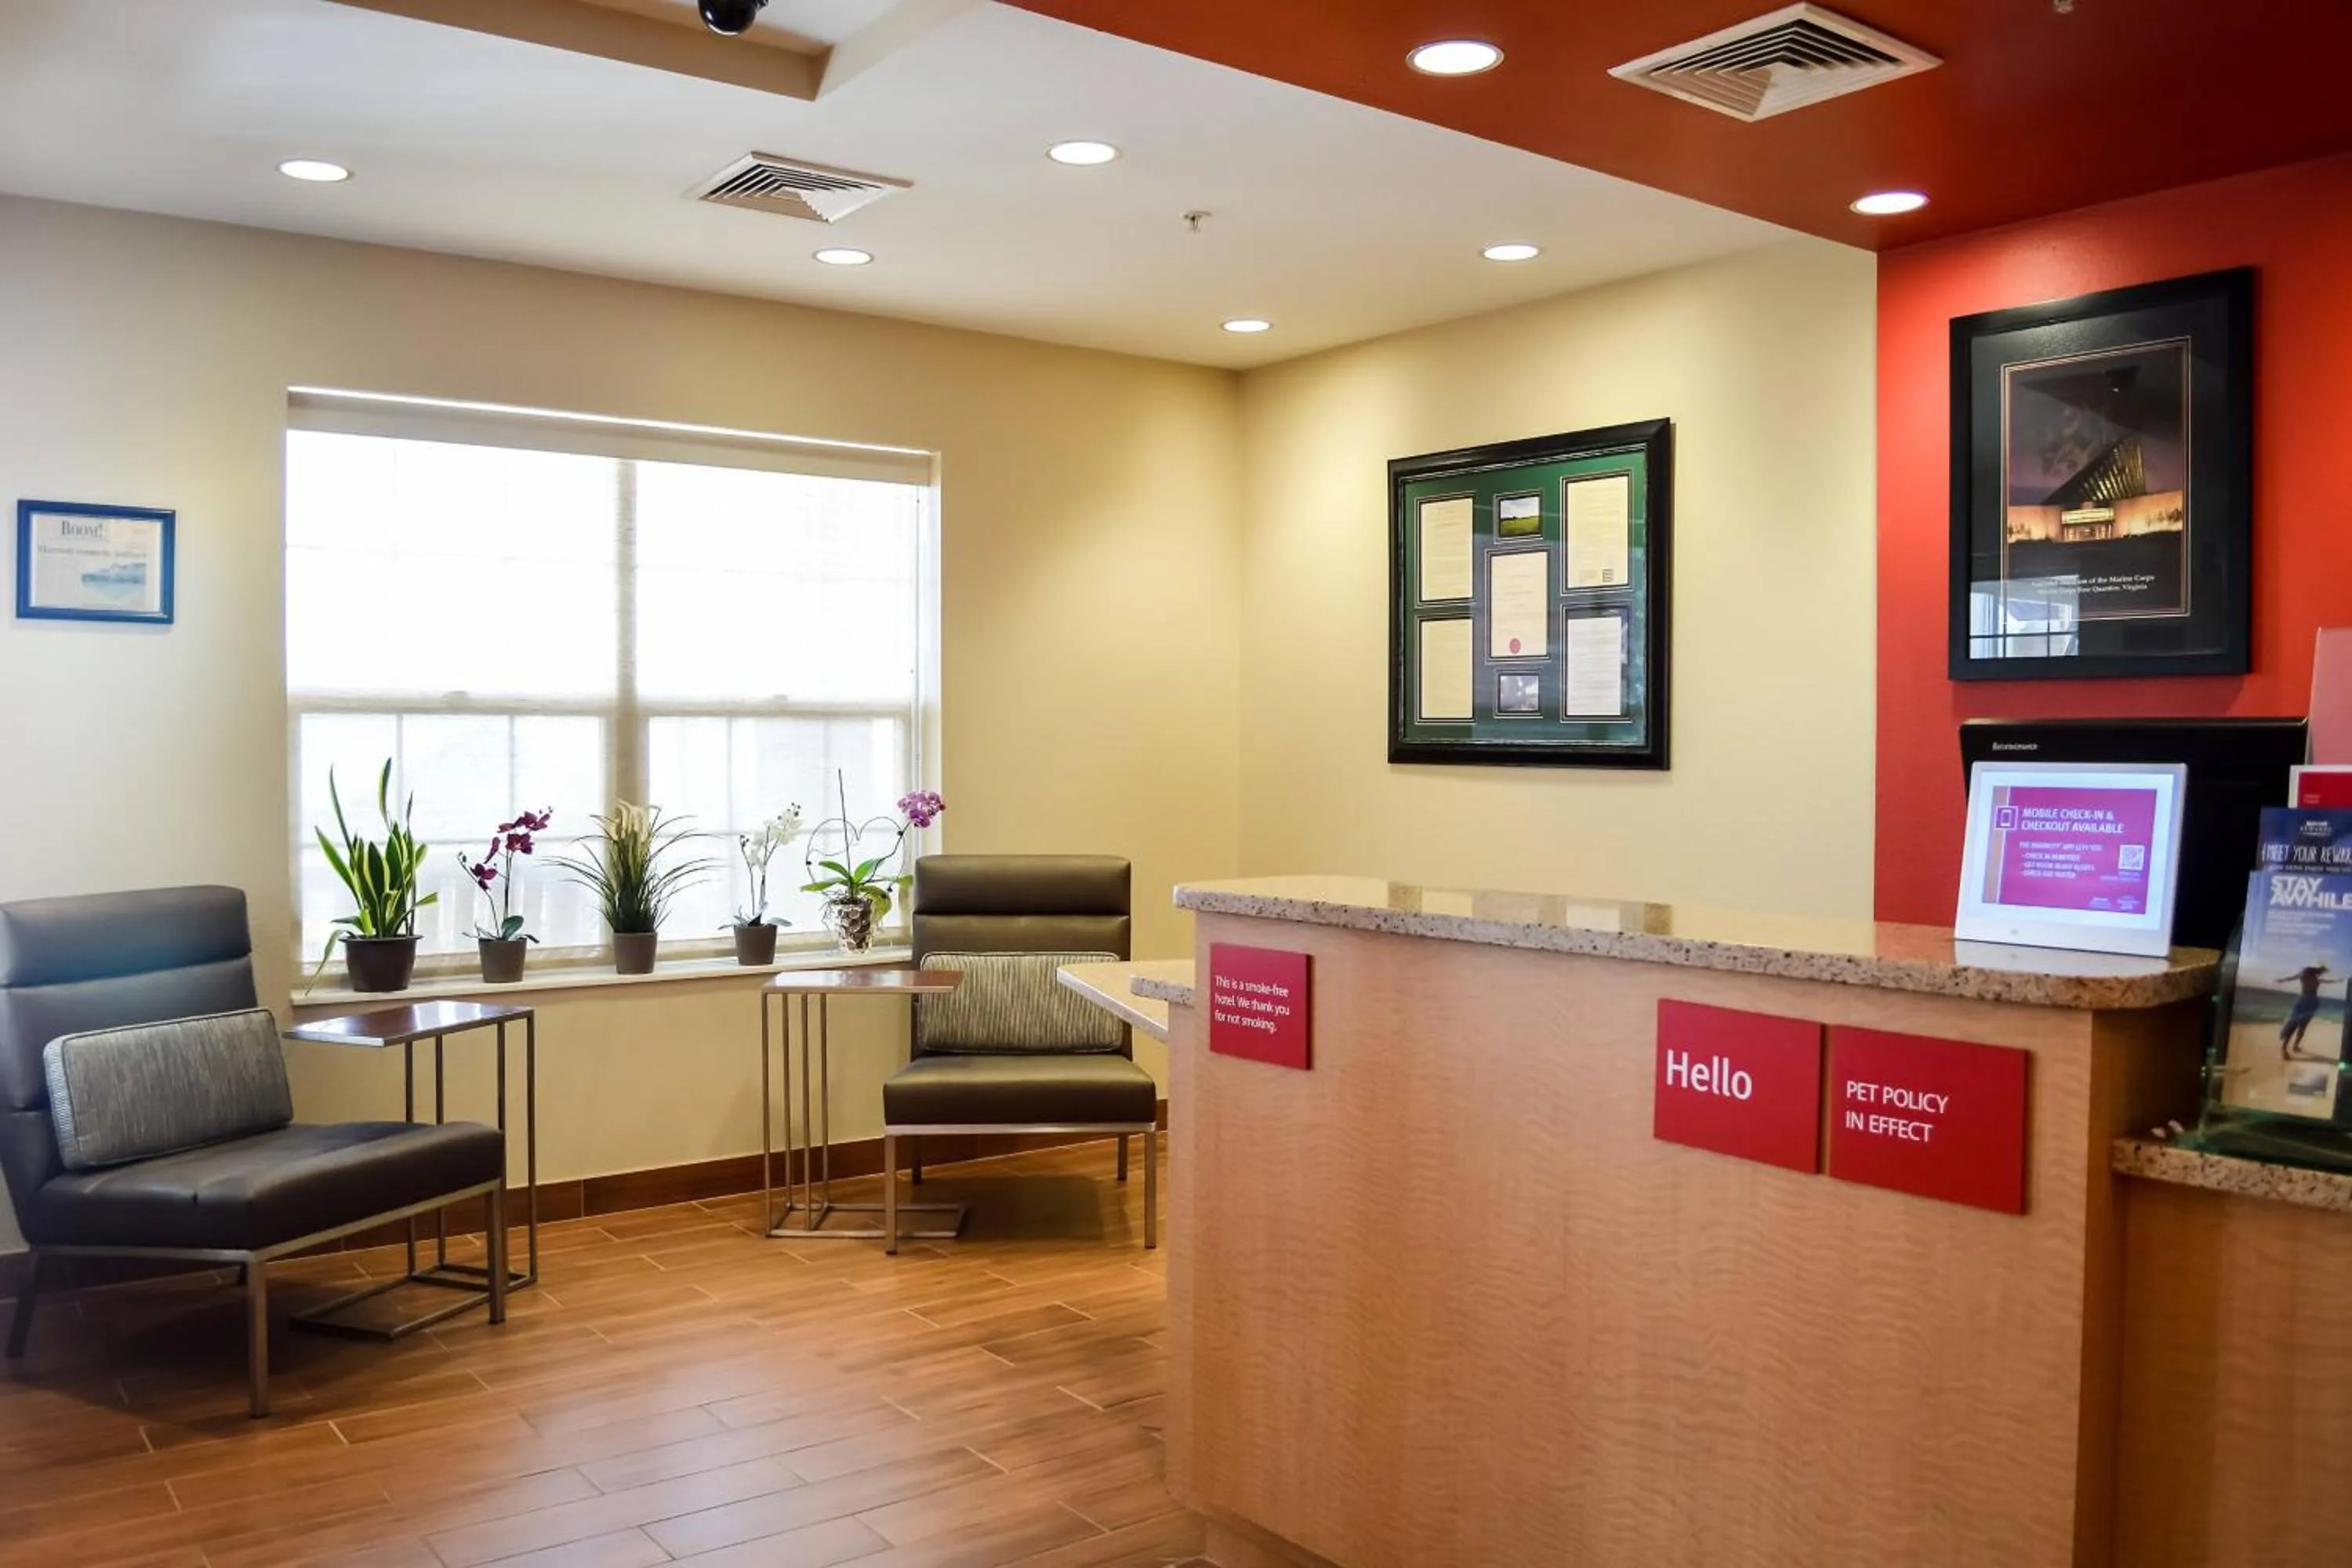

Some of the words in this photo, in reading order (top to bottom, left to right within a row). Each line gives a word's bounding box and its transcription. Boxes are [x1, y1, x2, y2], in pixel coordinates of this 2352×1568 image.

[2022, 808, 2058, 818] MOBILE
[2021, 821, 2070, 832] CHECKOUT
[2071, 822, 2125, 834] AVAILABLE
[2270, 875, 2323, 894] STAY
[2270, 891, 2352, 909] AWHILE
[1215, 975, 1230, 989] This
[1232, 978, 1238, 990] is
[1239, 980, 1244, 990] a
[1245, 982, 1290, 997] smoke-free
[1237, 995, 1250, 1009] We
[1251, 998, 1274, 1013] thank
[1274, 1004, 1290, 1016] you
[1214, 1009, 1226, 1022] for
[1227, 1014, 1241, 1025] not
[1242, 1016, 1277, 1035] smoking.
[1666, 1048, 1753, 1101] Hello
[1846, 1080, 1879, 1103] PET
[1882, 1085, 1949, 1114] POLICY
[1845, 1109, 1864, 1131] IN
[1869, 1113, 1934, 1142] EFFECT
